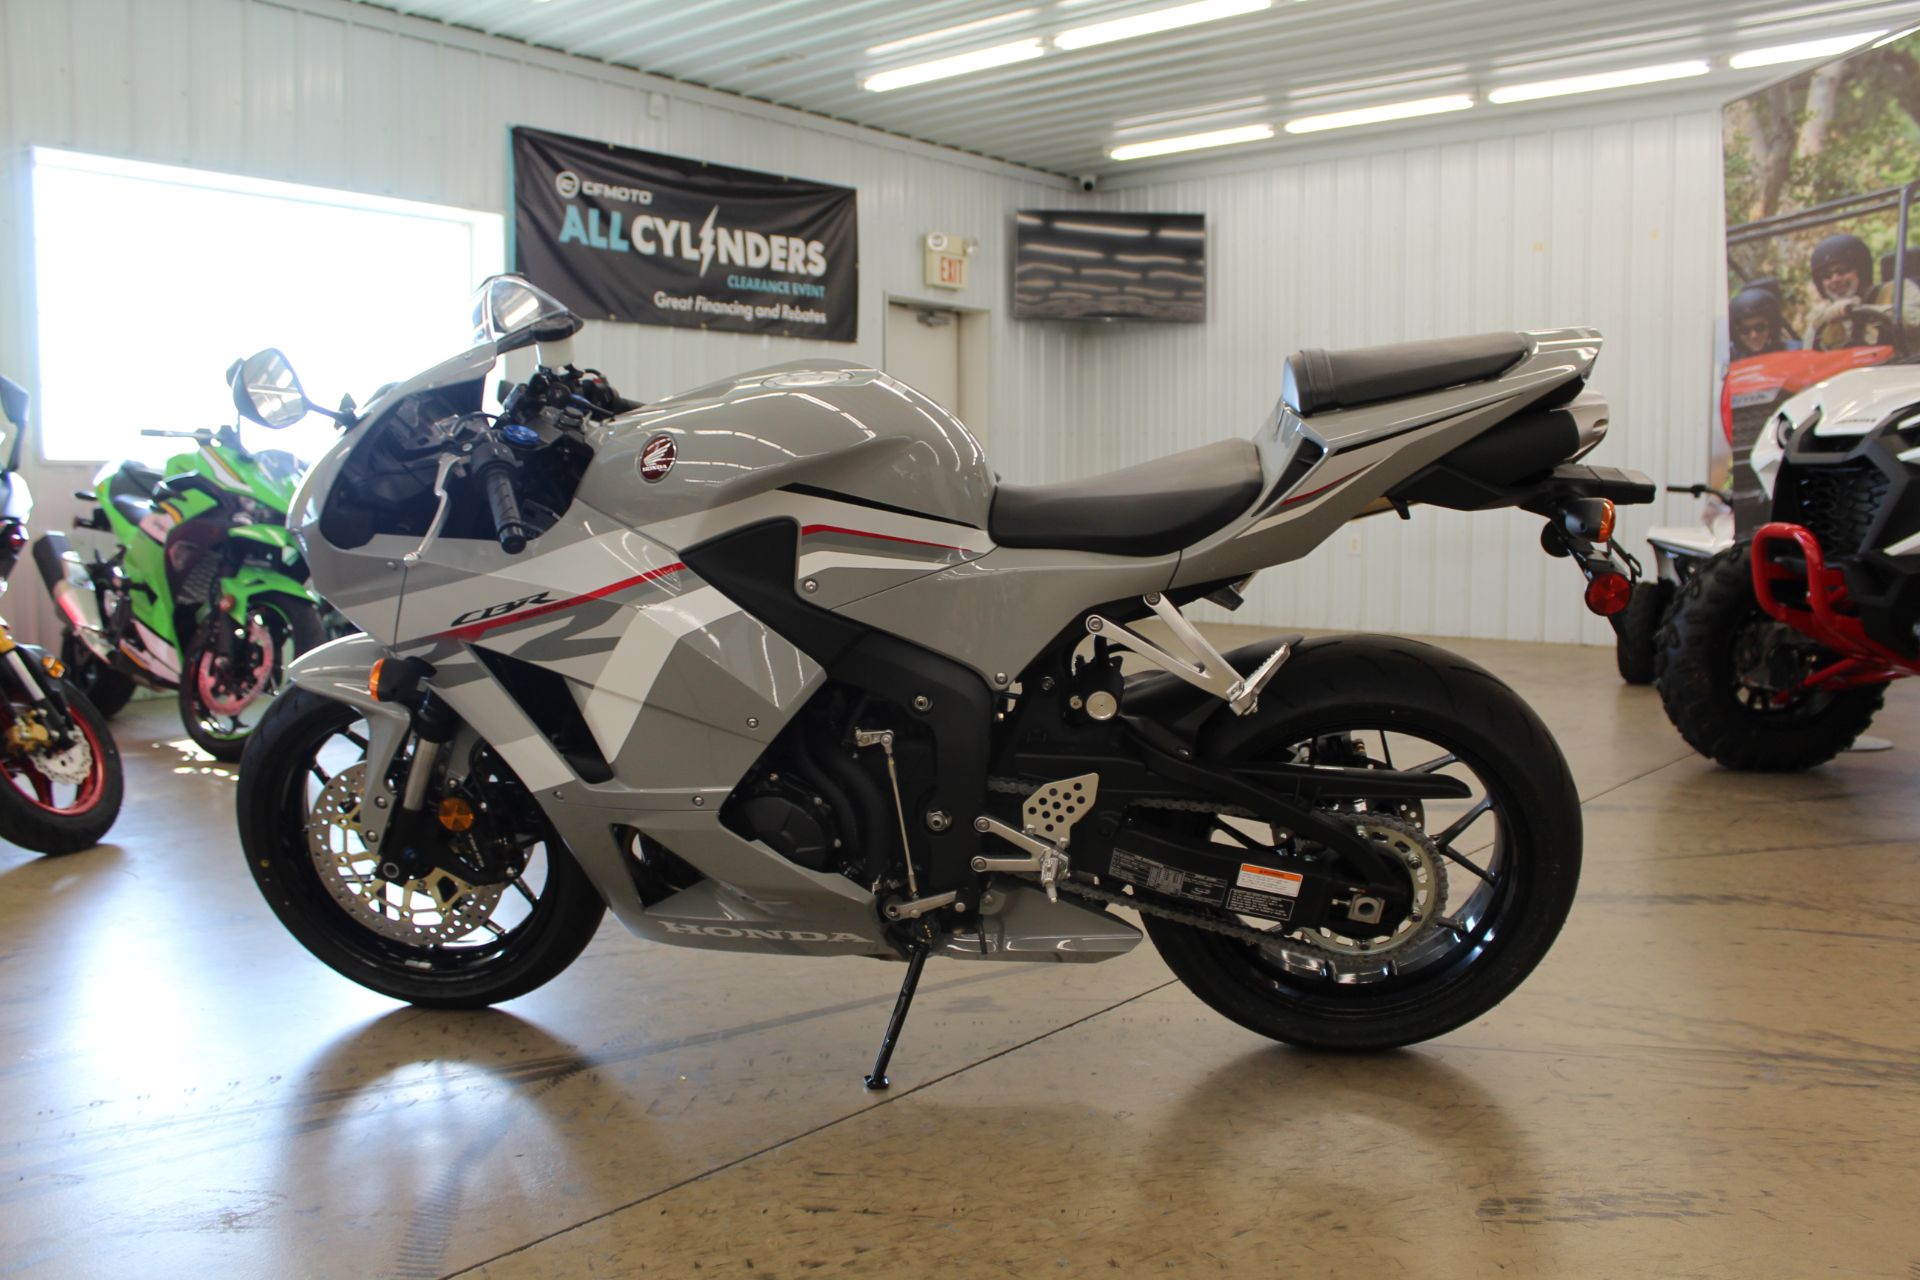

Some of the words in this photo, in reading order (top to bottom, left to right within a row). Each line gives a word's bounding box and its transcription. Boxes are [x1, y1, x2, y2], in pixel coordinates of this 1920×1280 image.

[582, 181, 652, 205] CFMOTO
[559, 204, 629, 251] ALL
[631, 205, 827, 277] CYLINDERS
[940, 256, 964, 285] EXIT
[727, 275, 790, 294] CLEARANCE
[792, 281, 826, 298] EVENT
[654, 291, 693, 310] Great
[695, 295, 754, 321] Financing
[755, 303, 781, 319] and
[782, 304, 827, 324] Rebates
[450, 591, 558, 627] CBR
[658, 920, 875, 943] HONDA
